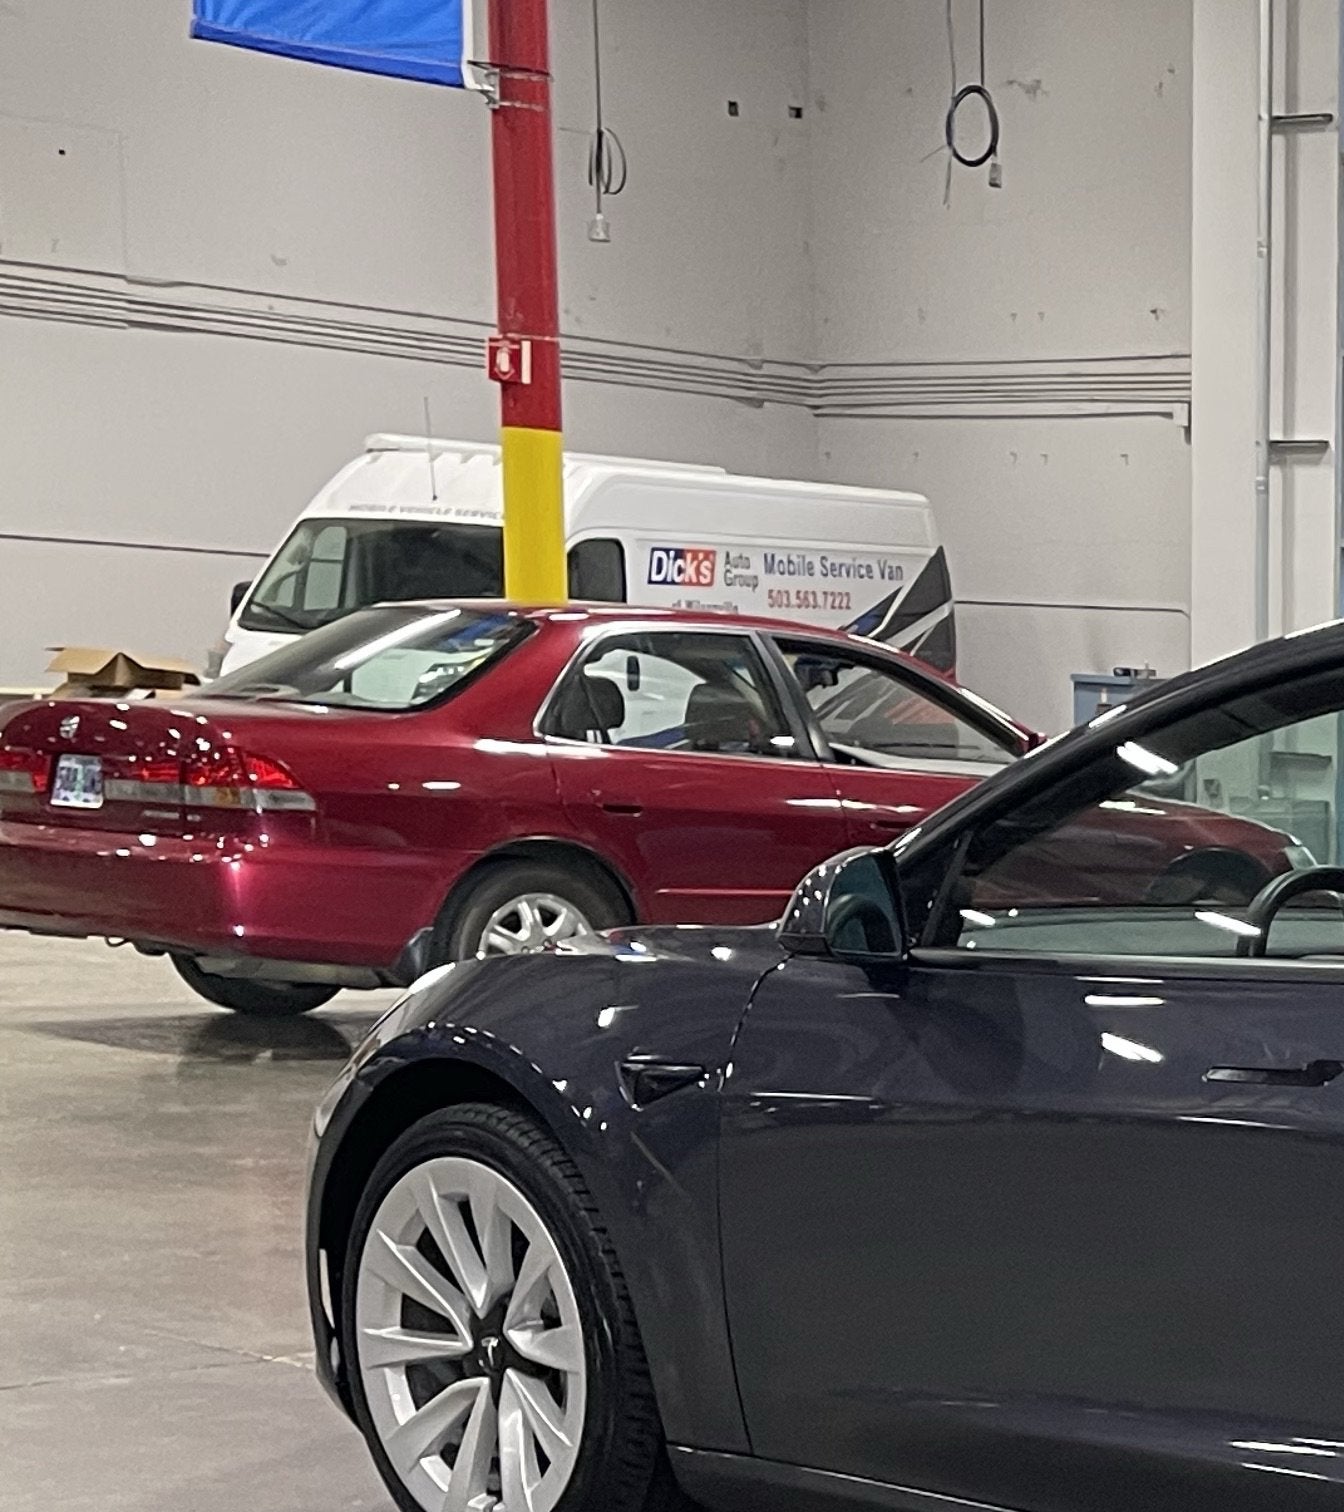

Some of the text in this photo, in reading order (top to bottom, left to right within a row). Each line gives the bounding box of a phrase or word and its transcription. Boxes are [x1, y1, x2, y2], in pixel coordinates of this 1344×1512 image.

[650, 550, 713, 584] Dick's
[724, 550, 751, 569] Auto
[763, 552, 904, 581] Mobile Service Van
[724, 569, 759, 592] Group
